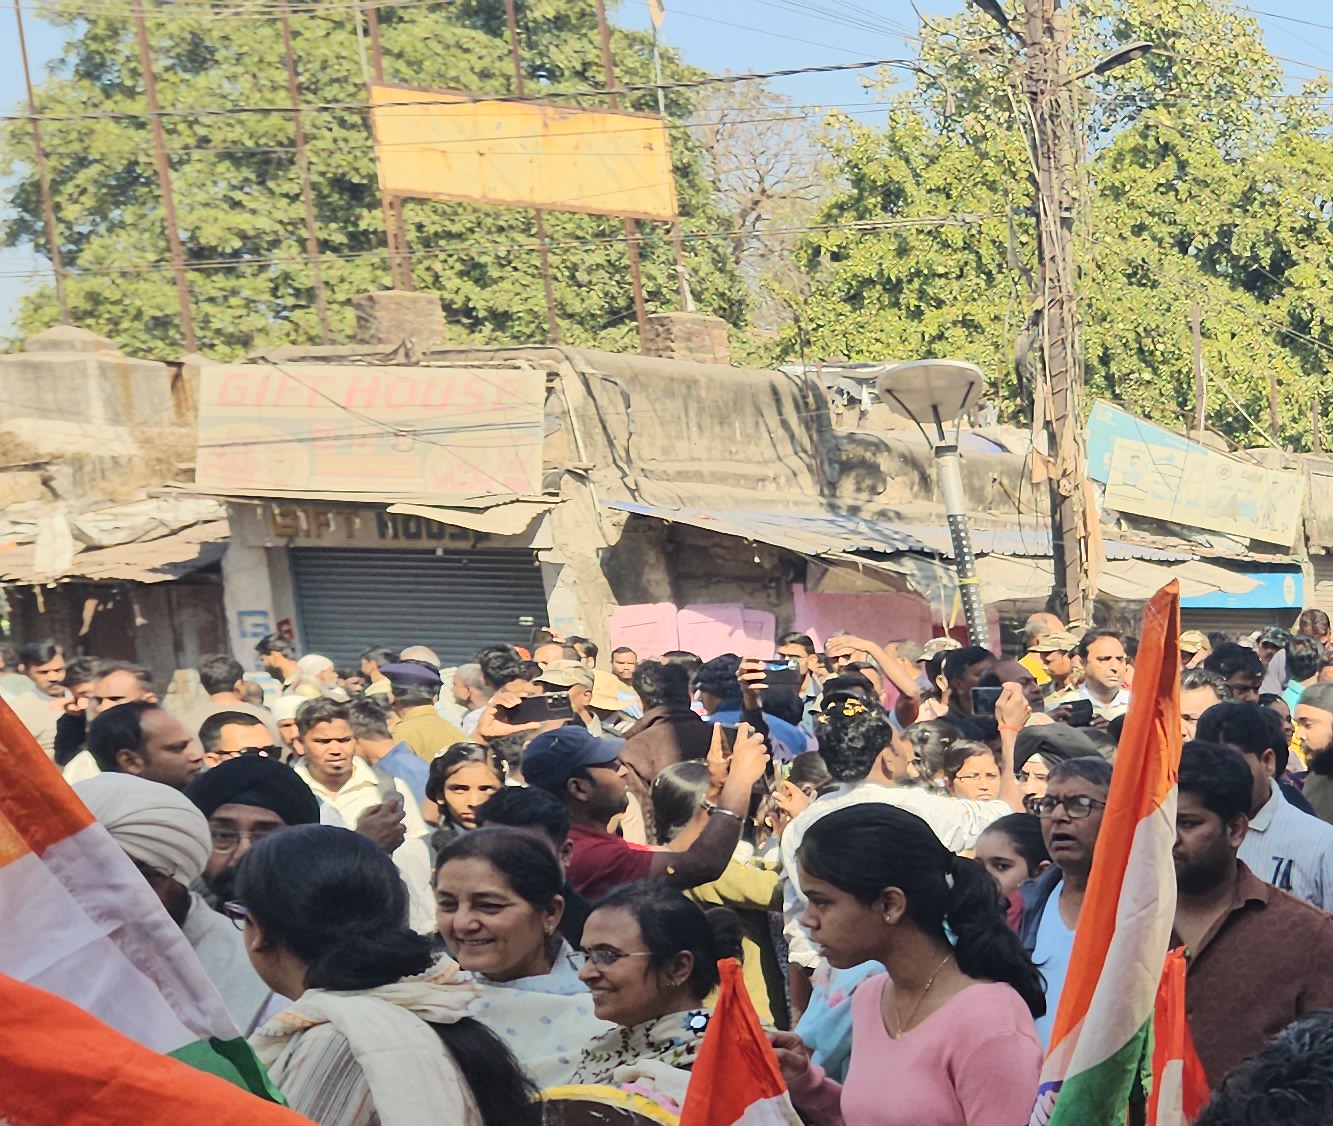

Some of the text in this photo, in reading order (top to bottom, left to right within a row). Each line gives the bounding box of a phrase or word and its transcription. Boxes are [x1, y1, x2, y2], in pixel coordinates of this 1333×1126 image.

[218, 372, 527, 412] GIFT HOUSE
[273, 507, 359, 539] GIFT
